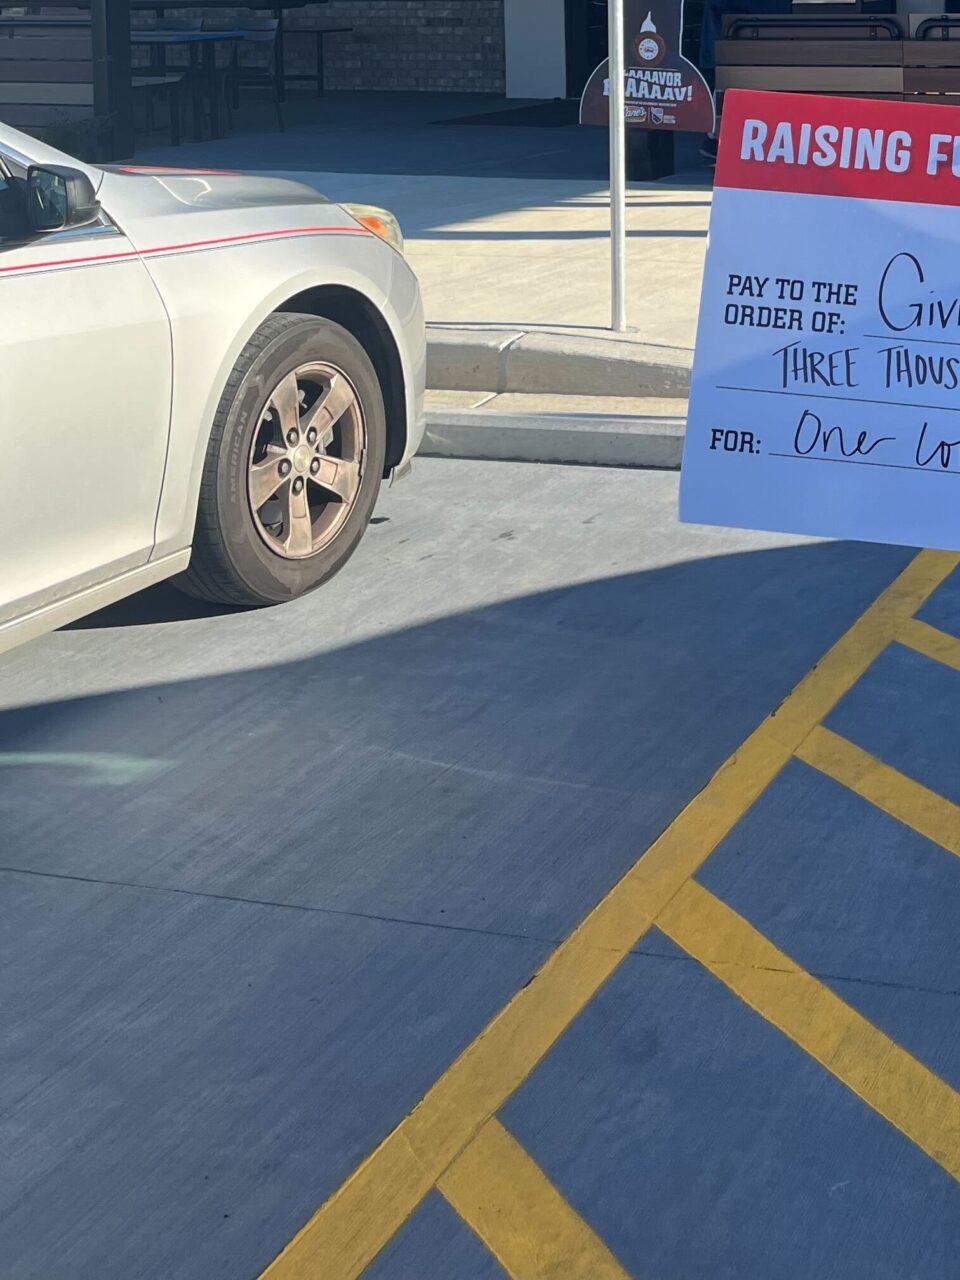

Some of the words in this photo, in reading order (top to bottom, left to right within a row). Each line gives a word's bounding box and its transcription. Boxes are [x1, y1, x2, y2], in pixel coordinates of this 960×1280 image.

[740, 119, 911, 173] RAISING
[726, 274, 770, 298] PAY
[775, 279, 804, 301] TO
[812, 282, 858, 306] THE
[724, 303, 803, 331] ORDER
[811, 311, 846, 335] OF:
[772, 342, 861, 390] THREE
[709, 428, 762, 455] FOR:
[793, 409, 896, 457] One
[230, 411, 247, 504] AMERICAN
